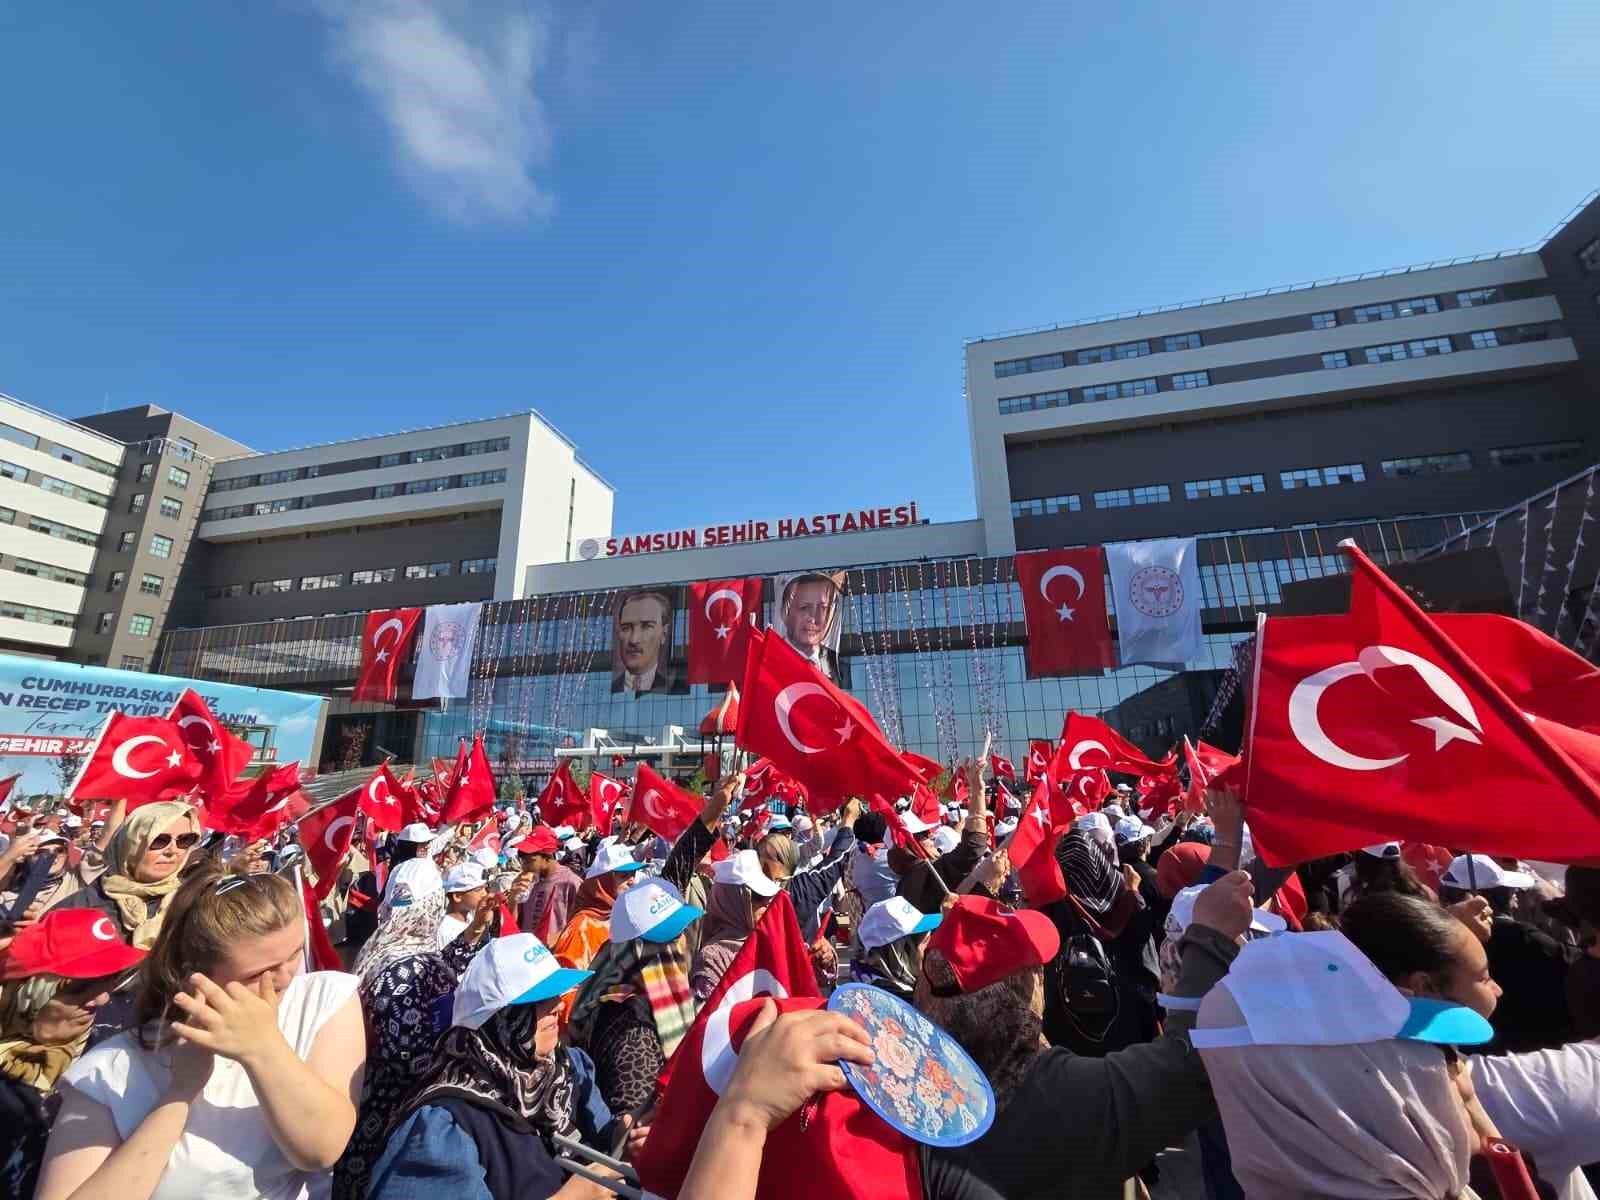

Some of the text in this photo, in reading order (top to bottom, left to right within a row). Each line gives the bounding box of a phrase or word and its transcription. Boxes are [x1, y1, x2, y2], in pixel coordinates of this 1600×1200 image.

[606, 528, 696, 556] SAMSUN
[778, 501, 917, 538] HASTANESİ
[17, 694, 91, 711] RECEP
